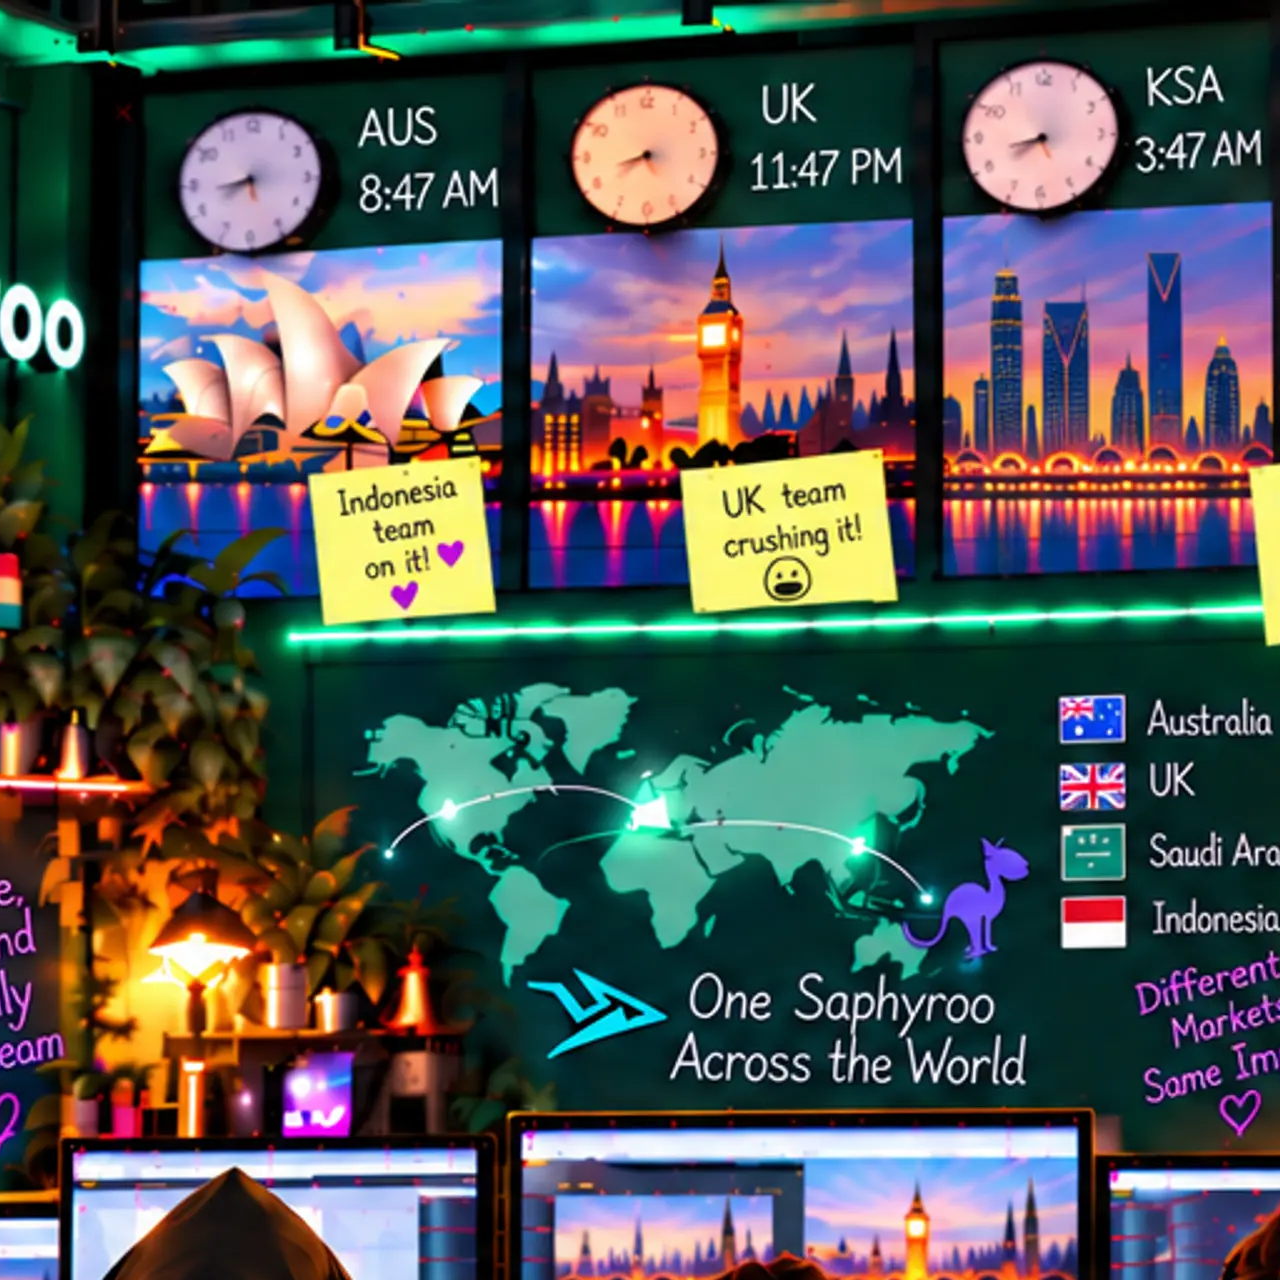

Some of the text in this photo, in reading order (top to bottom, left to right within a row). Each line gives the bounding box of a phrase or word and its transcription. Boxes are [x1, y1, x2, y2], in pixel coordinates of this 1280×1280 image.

[763, 83, 816, 124] UK
[1148, 65, 1224, 106] KSA
[358, 107, 436, 147] AUS
[752, 147, 901, 190] 11:47 PM
[1136, 130, 1261, 172] 3:47 AM
[360, 168, 498, 212] 8:47 AM
[338, 477, 457, 516] Indonesia
[723, 483, 846, 518] UK team
[373, 520, 434, 543] team
[724, 513, 861, 558] crushing it!
[365, 546, 430, 579] on it!
[1148, 698, 1272, 735] Australia
[1150, 762, 1194, 796] UK
[1150, 832, 1222, 867] Saudi
[1153, 899, 1280, 934] Indonesia
[690, 973, 771, 1020] One
[795, 973, 996, 1042] Saphyroo
[670, 1032, 1026, 1085] Across the World
